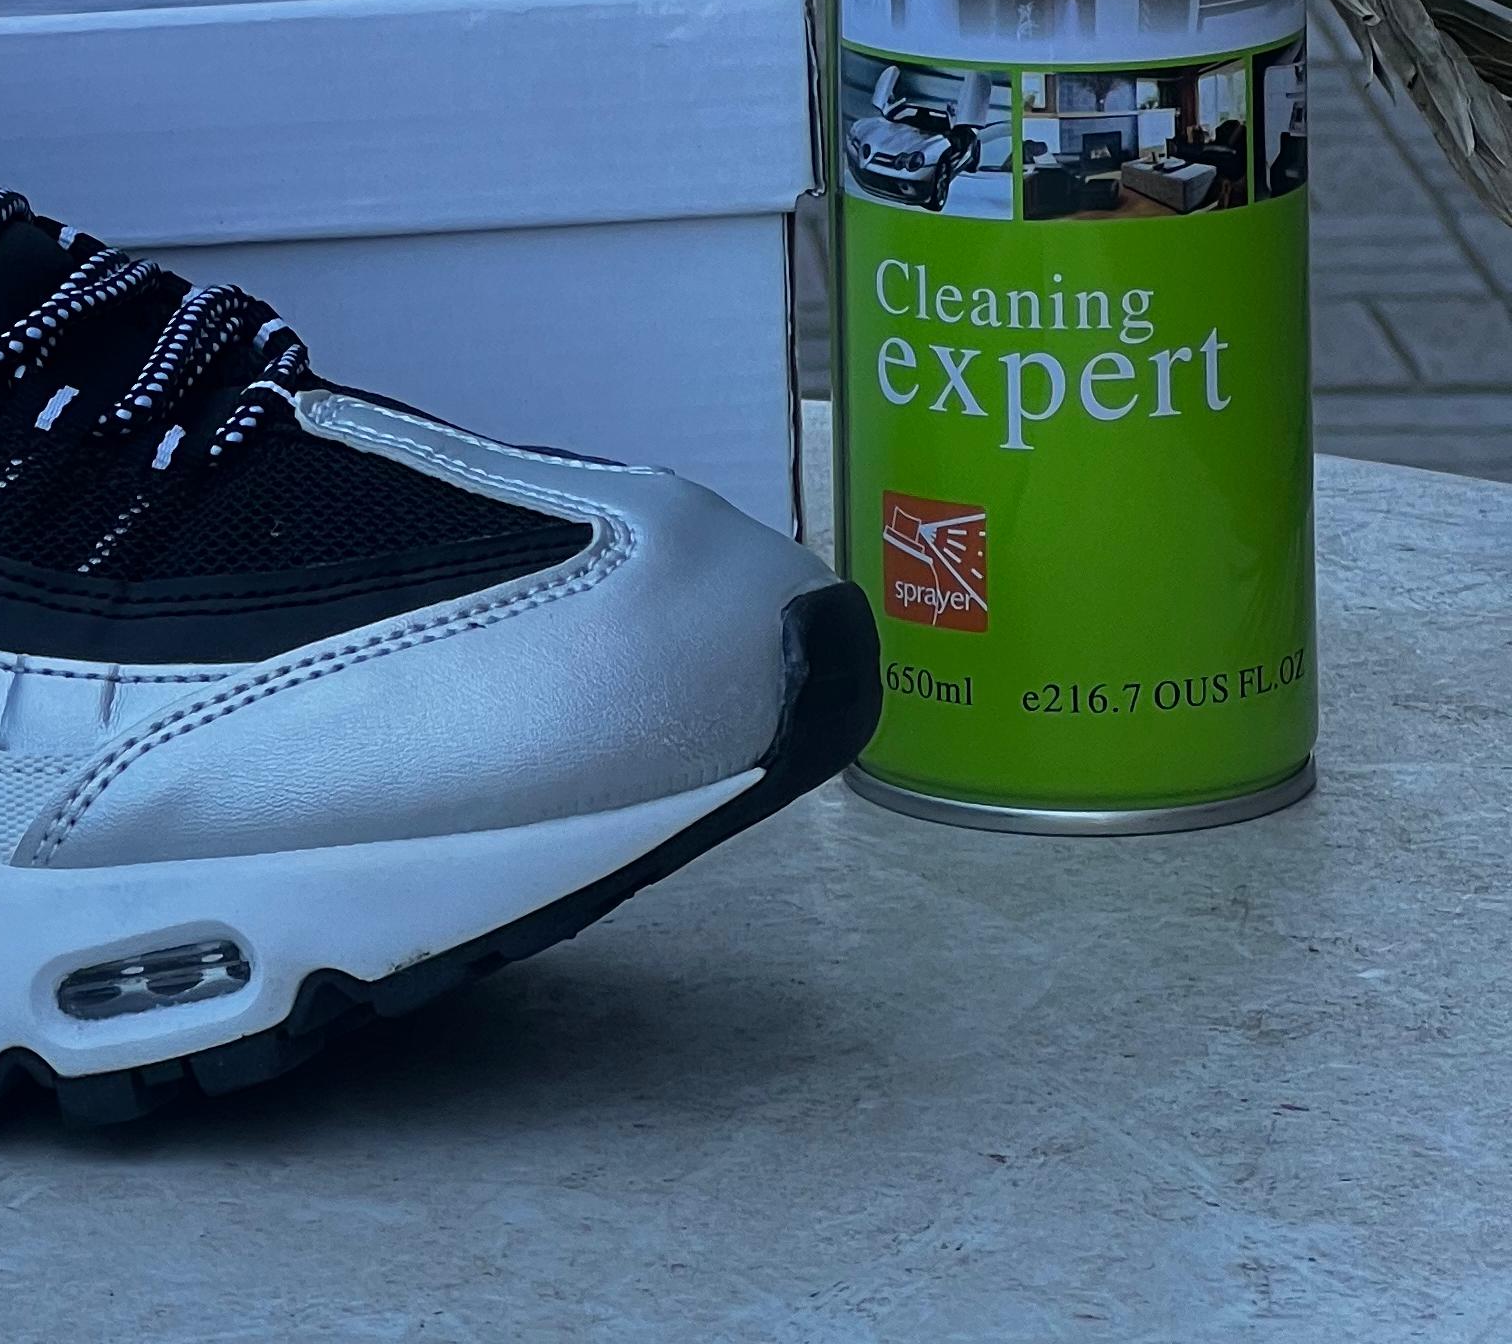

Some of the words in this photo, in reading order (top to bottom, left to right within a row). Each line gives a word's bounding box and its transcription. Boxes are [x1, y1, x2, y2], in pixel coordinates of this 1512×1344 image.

[875, 258, 1155, 345] Cleaning
[877, 326, 1232, 451] expert
[894, 578, 973, 615] sprayer
[886, 662, 974, 706] 650ml
[1153, 673, 1229, 710] OUS
